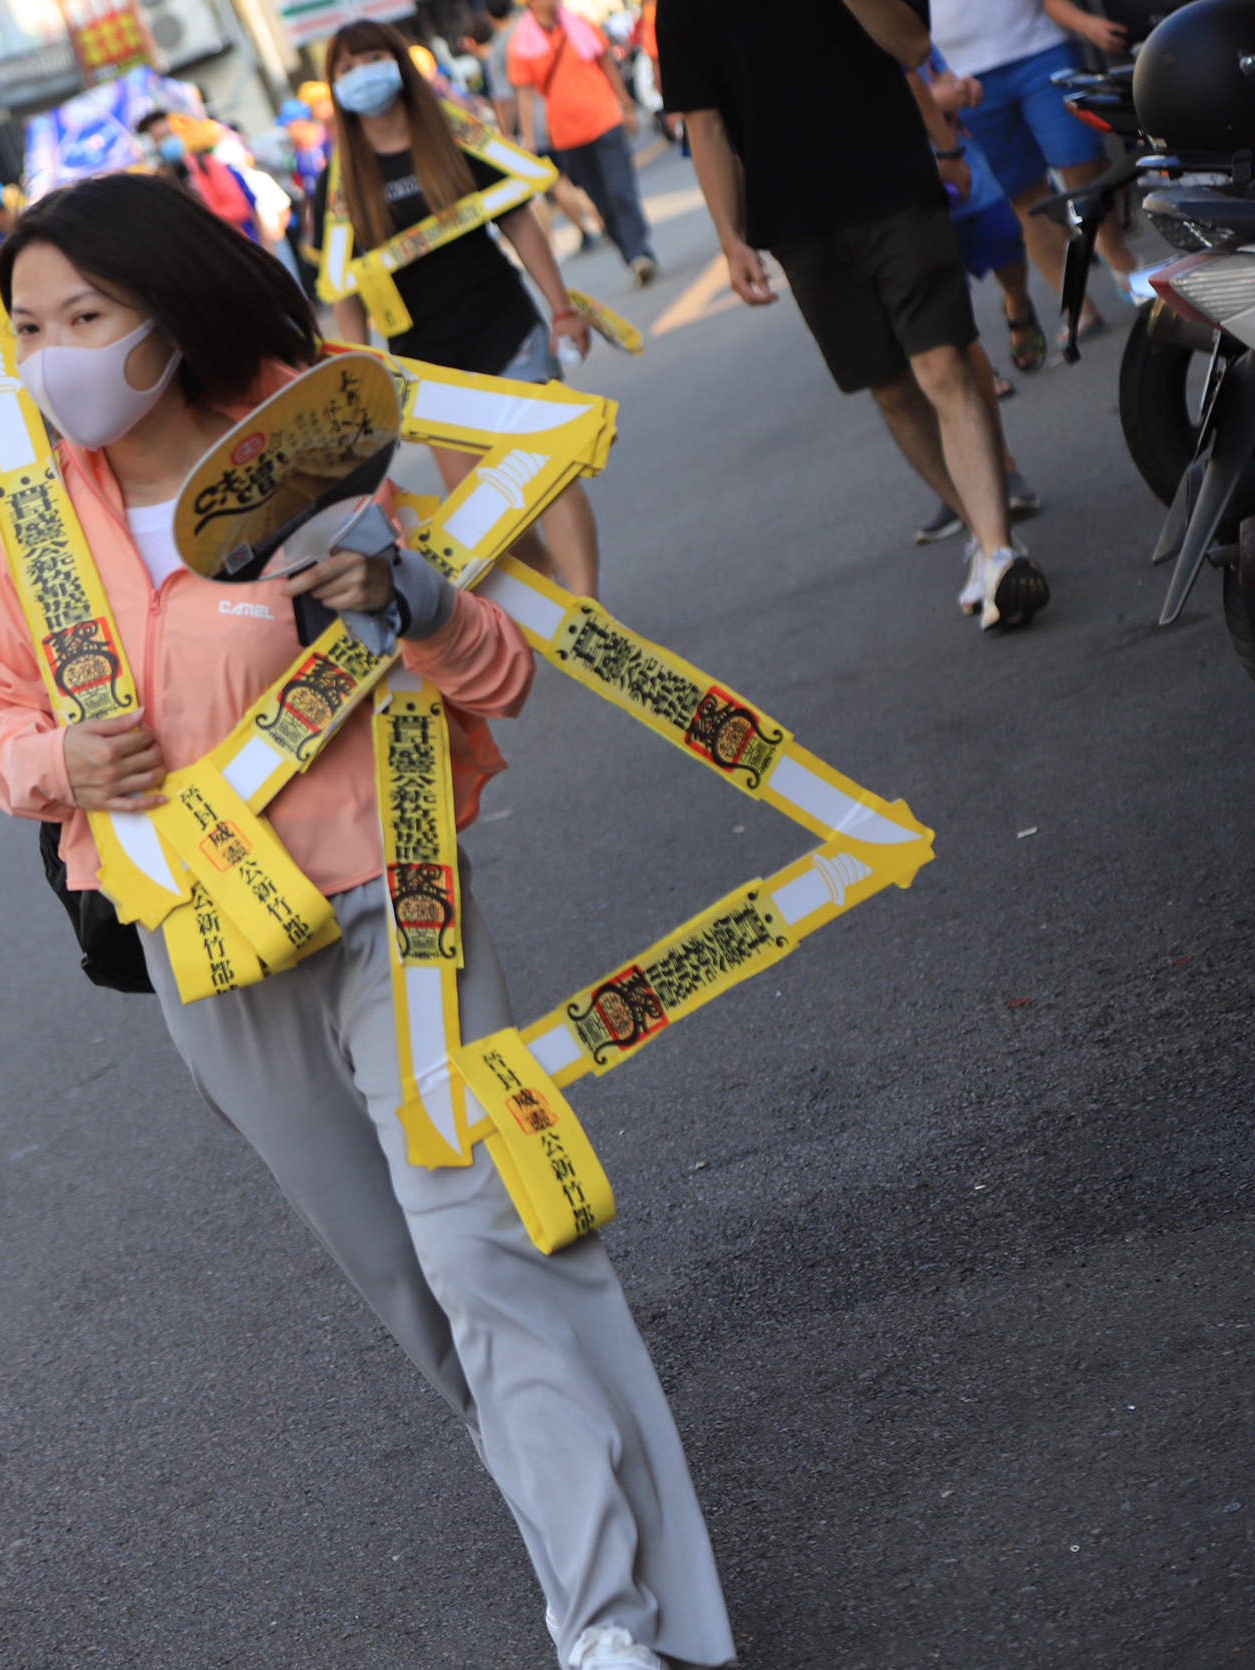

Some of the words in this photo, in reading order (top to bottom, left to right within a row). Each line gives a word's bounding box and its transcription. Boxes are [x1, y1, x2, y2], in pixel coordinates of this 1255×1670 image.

[218, 599, 275, 620] CAMEL
[178, 783, 314, 950] 晉封威靈公新竹都
